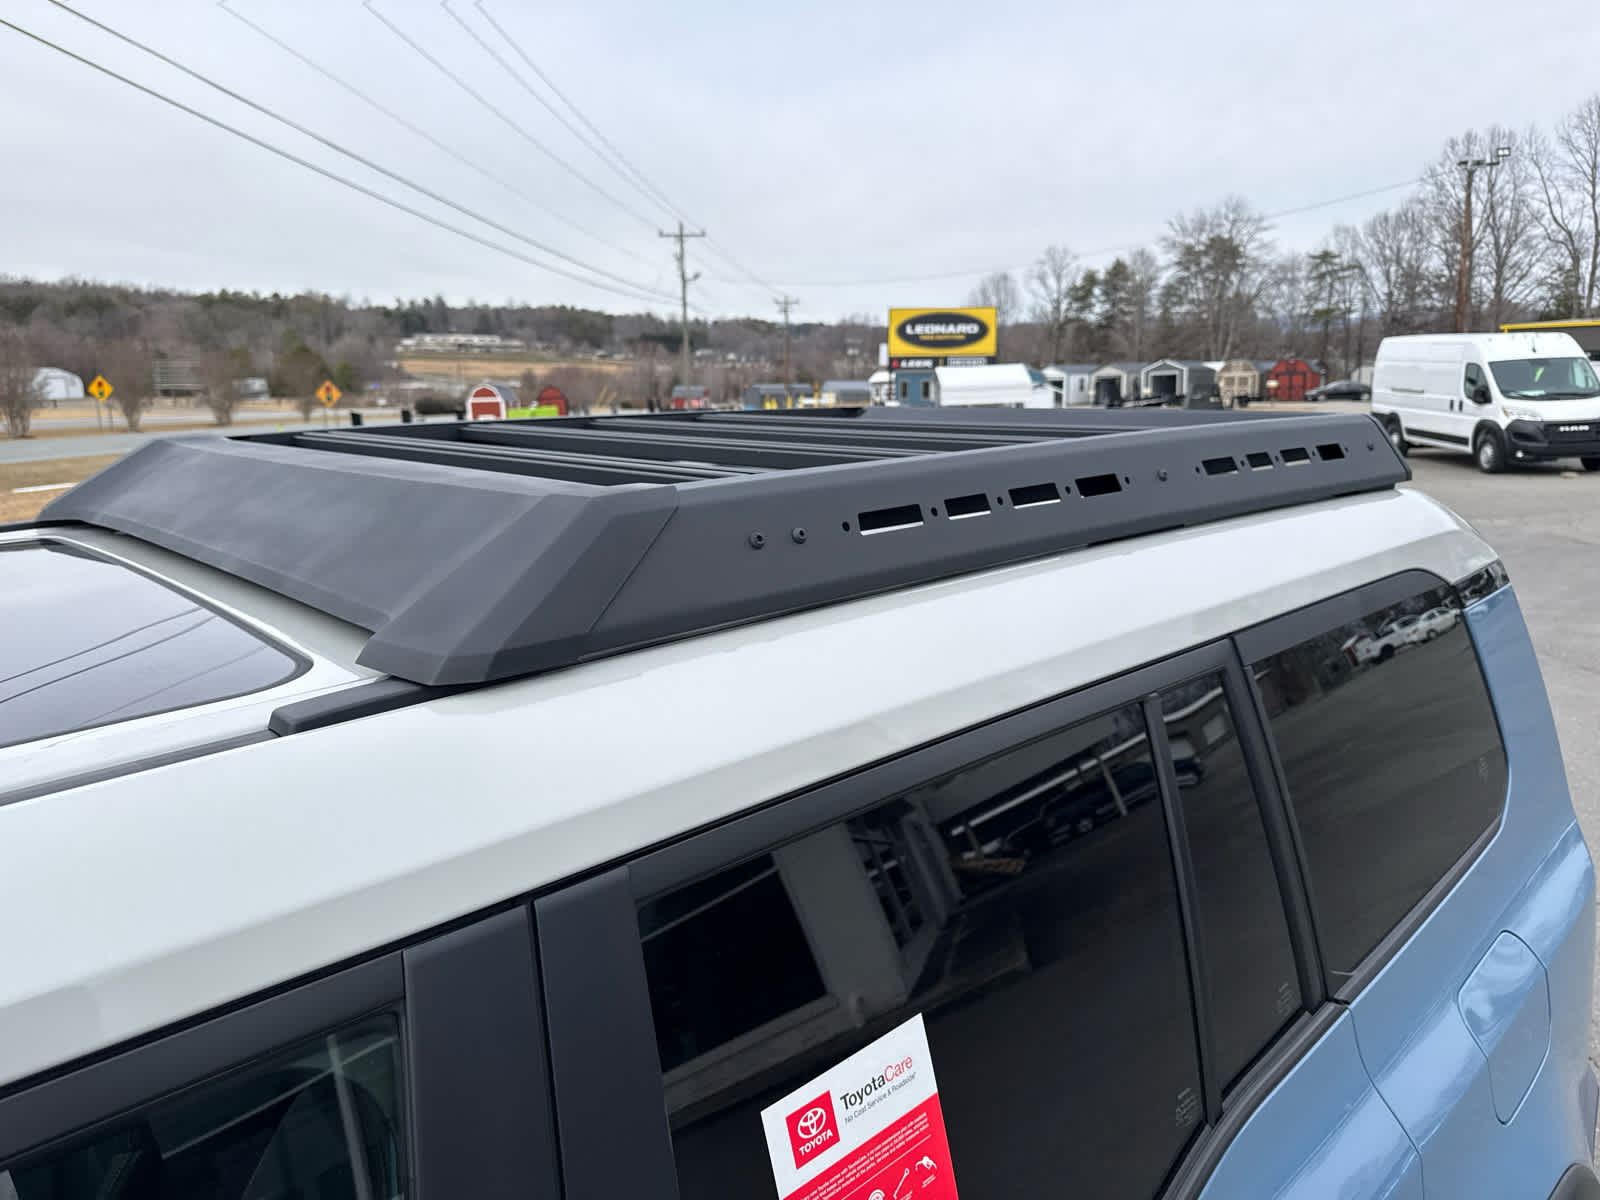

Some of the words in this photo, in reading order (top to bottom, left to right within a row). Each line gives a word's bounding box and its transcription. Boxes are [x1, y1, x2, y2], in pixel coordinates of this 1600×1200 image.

[905, 323, 979, 335] LEONARD
[840, 1056, 912, 1110] ToyotaCare
[844, 1114, 854, 1124] No
[853, 1106, 867, 1118] Cost
[867, 1093, 887, 1110] Service
[799, 1129, 833, 1156] TOYOTA
